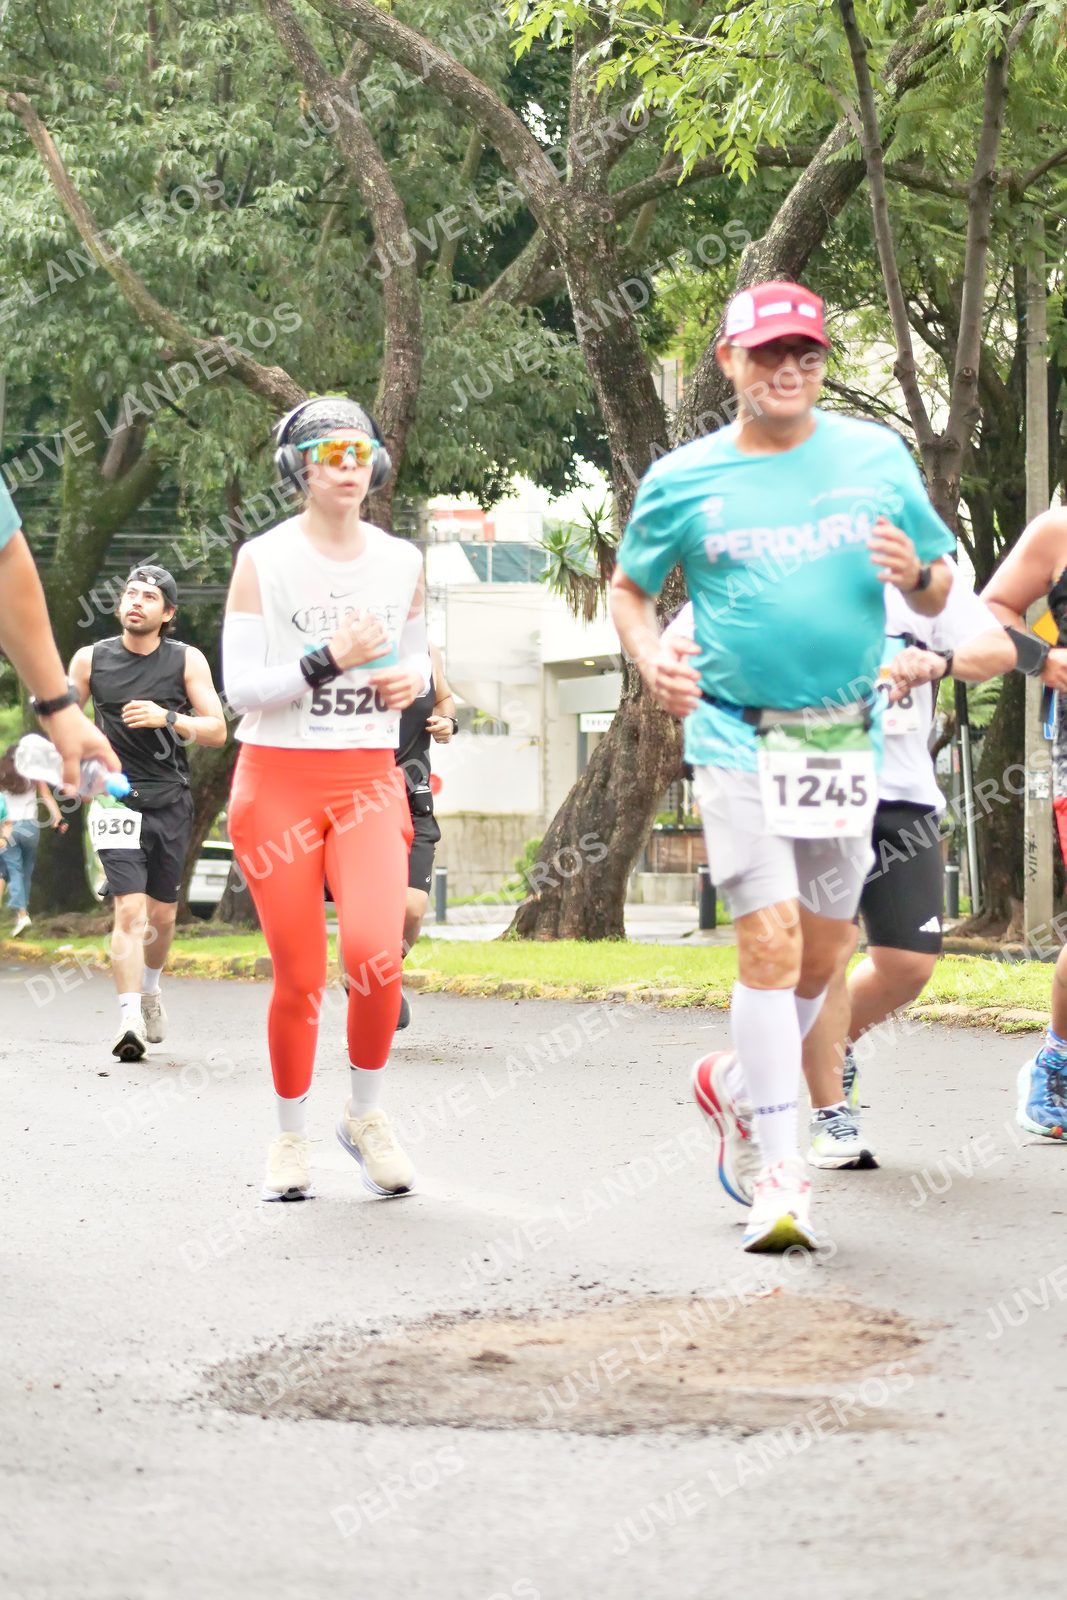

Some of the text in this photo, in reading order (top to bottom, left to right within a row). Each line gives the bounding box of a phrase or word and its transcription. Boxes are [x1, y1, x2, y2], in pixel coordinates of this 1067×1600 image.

[310, 686, 390, 717] 5520
[773, 774, 868, 807] 1245
[92, 818, 136, 836] 1930
